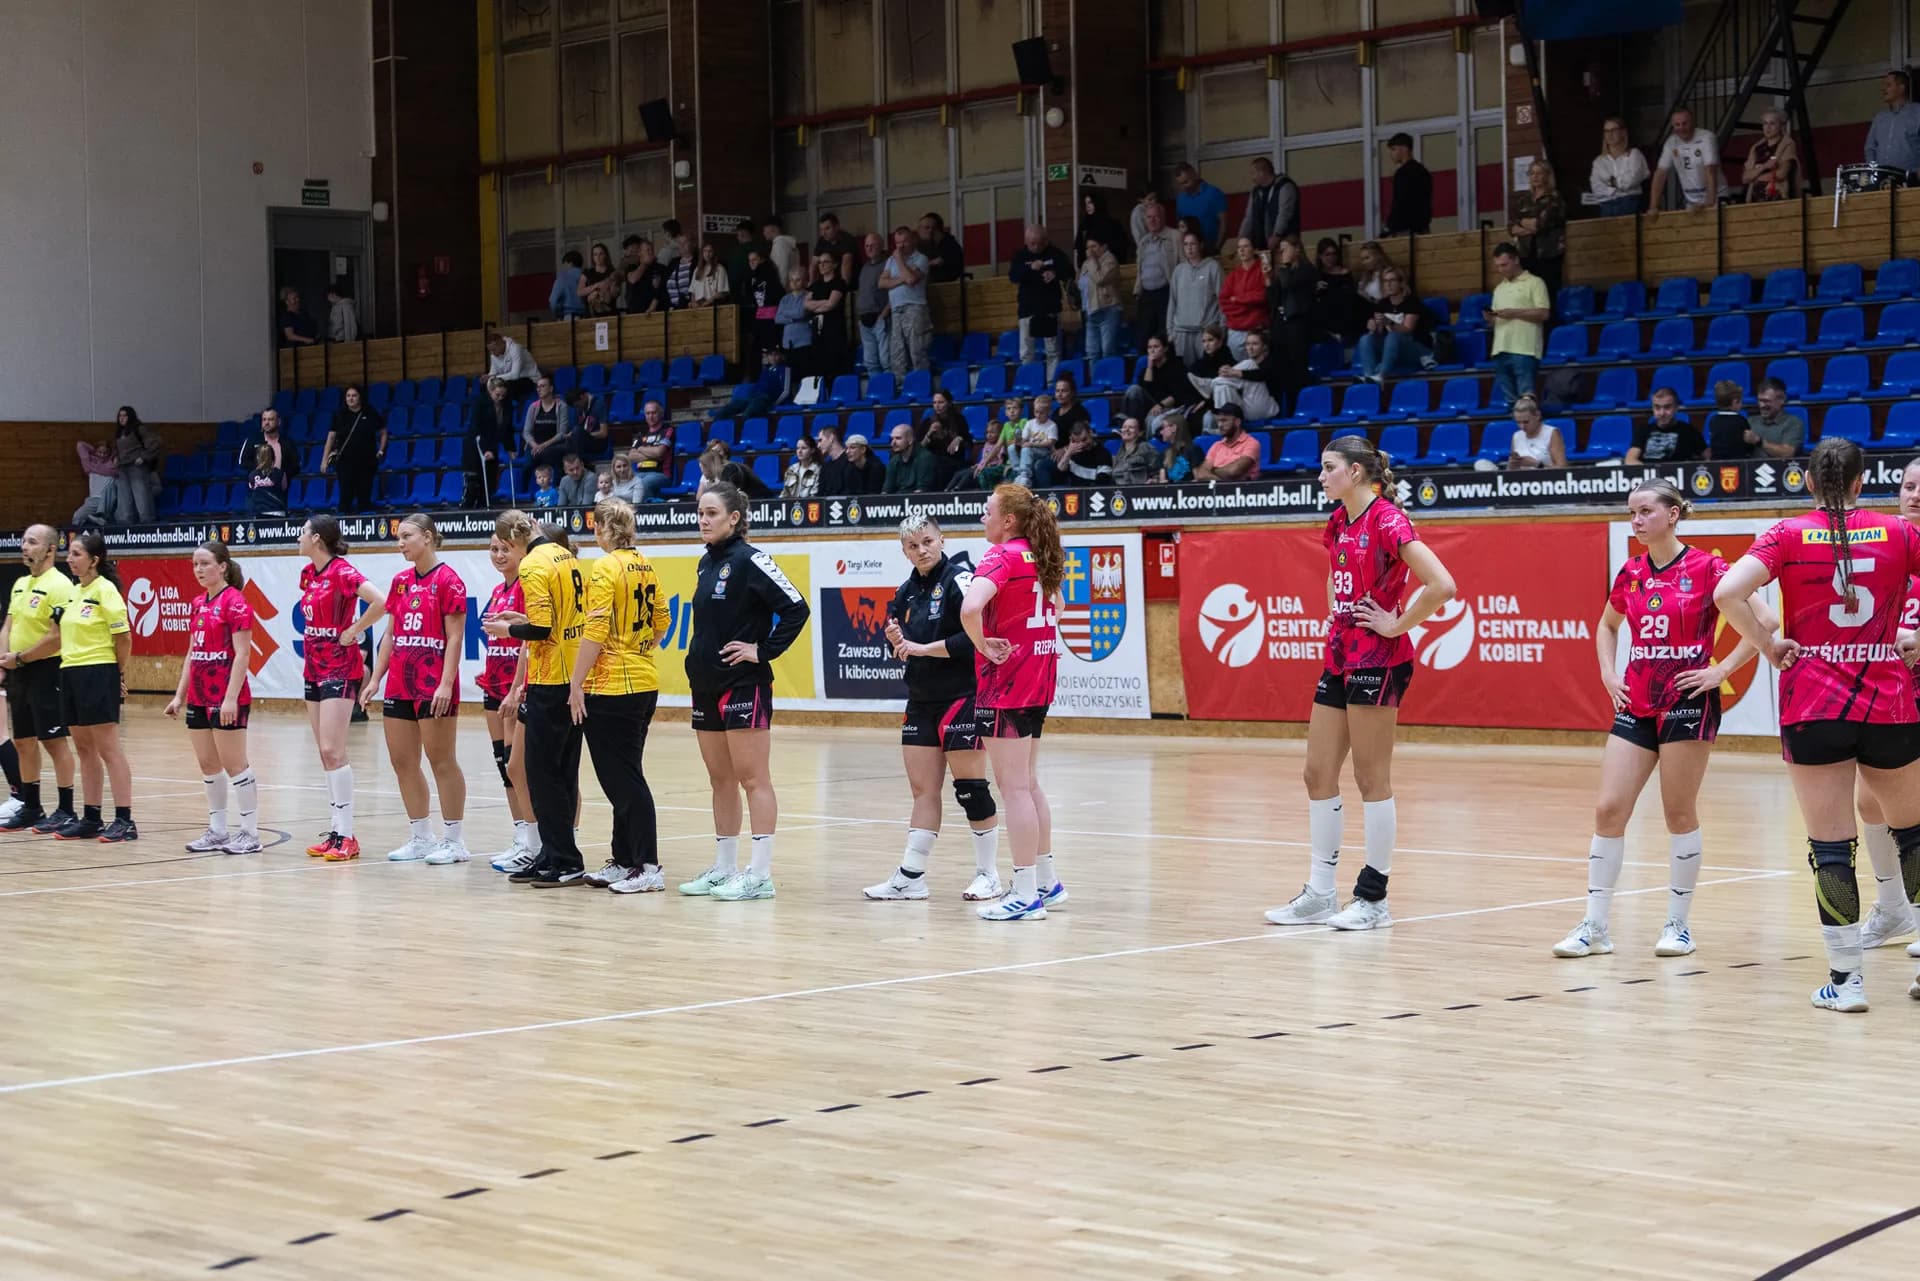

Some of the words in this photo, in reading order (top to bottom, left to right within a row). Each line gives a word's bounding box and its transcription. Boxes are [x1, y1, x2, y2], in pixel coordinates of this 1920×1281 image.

[1081, 173, 1097, 185] A
[706, 222, 719, 231] B
[104, 526, 206, 545] www.koronahandball.pl
[848, 560, 862, 570] Targi
[864, 560, 882, 569] Kielce
[1334, 570, 1353, 594] 33
[160, 586, 179, 600] LIGA
[1828, 558, 1875, 628] 5
[161, 602, 192, 616] CENTR
[1267, 596, 1304, 614] LIGA
[1477, 595, 1520, 614] LIGA
[1899, 598, 1920, 624] 2
[162, 618, 191, 631] KOBIET
[402, 612, 423, 631] 36
[1268, 619, 1329, 637] CENTRA
[1478, 619, 1590, 639] CENTRALNA
[1640, 614, 1669, 639] 29
[396, 635, 445, 650] SUZUKI
[838, 643, 881, 658] Zawsze
[1269, 641, 1326, 660] KOBIET
[1479, 643, 1545, 663] KOBIET
[1633, 645, 1703, 660] SUZUKI
[839, 664, 843, 680] i
[845, 664, 906, 680] kibicowani
